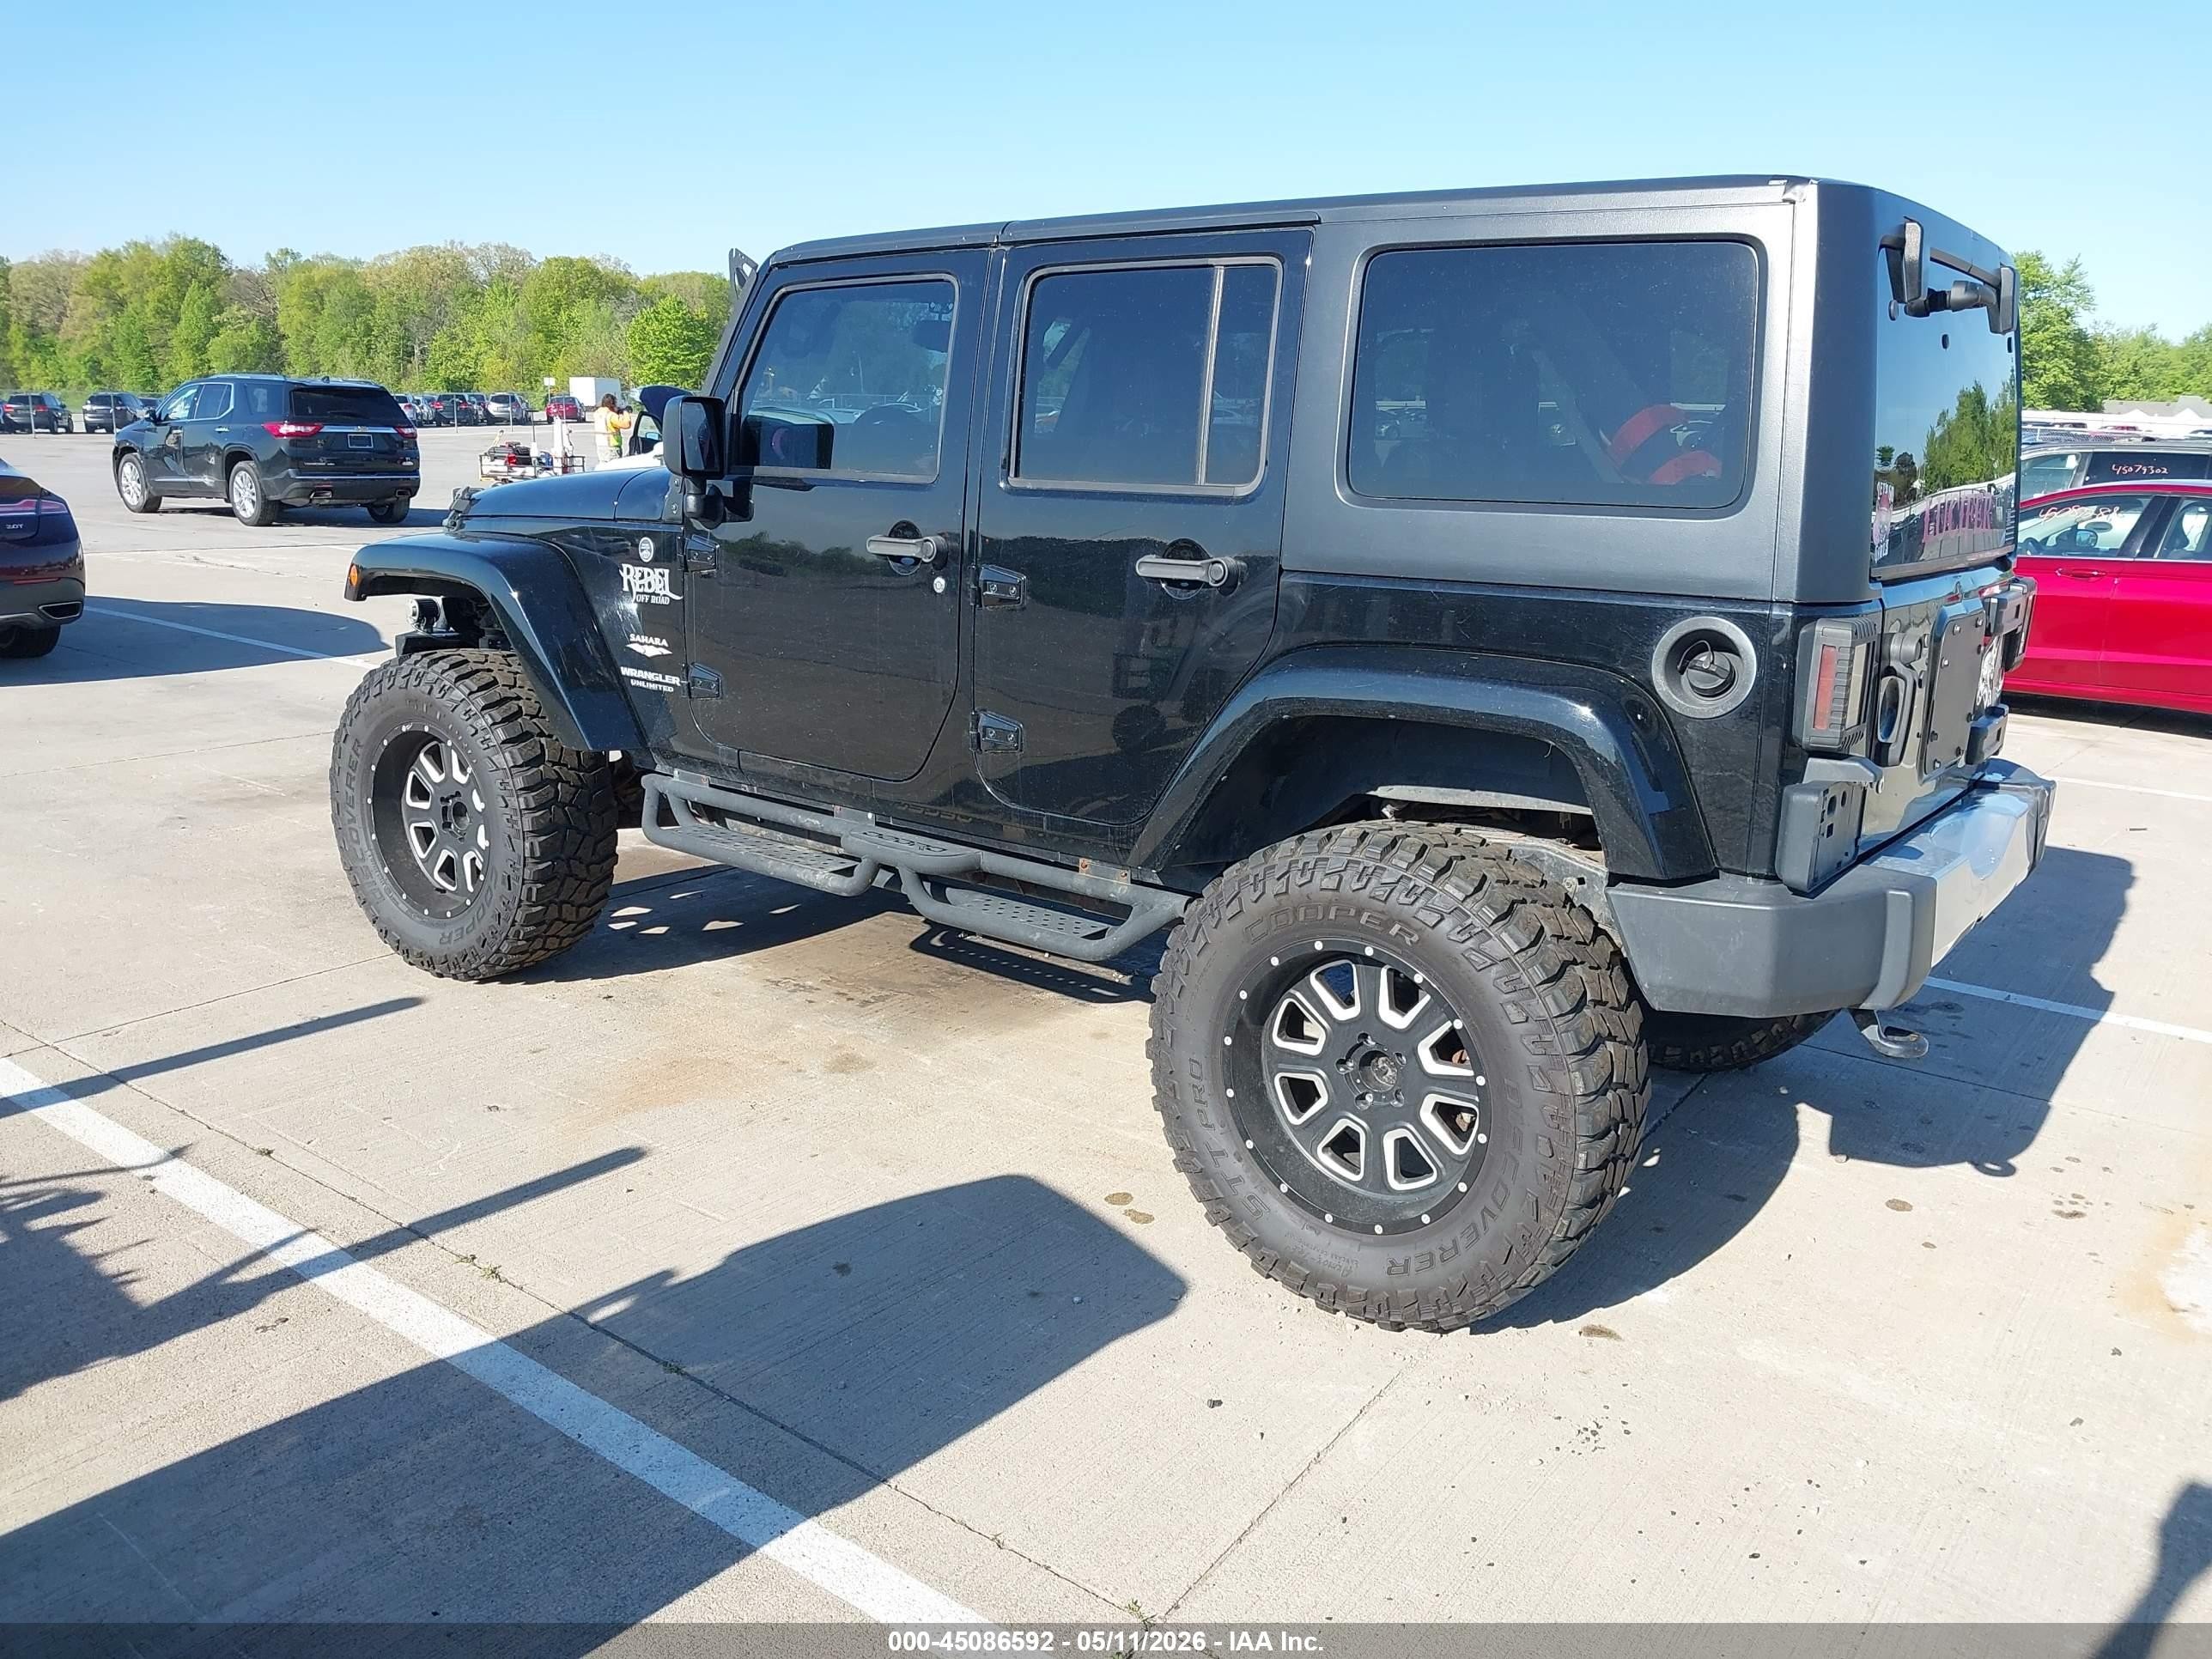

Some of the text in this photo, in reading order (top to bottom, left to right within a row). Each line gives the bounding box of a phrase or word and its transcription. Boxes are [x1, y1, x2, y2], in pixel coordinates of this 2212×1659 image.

[2112, 465, 2168, 475] 45079302
[619, 563, 683, 603] REBEL
[636, 594, 670, 605] OFF ROAD
[629, 633, 669, 647] SAHARA
[620, 666, 681, 686] WRANGLER
[630, 678, 674, 692] UNLIMITED
[1244, 903, 1419, 946] COOPER
[1188, 1057, 1271, 1220] STT PRO
